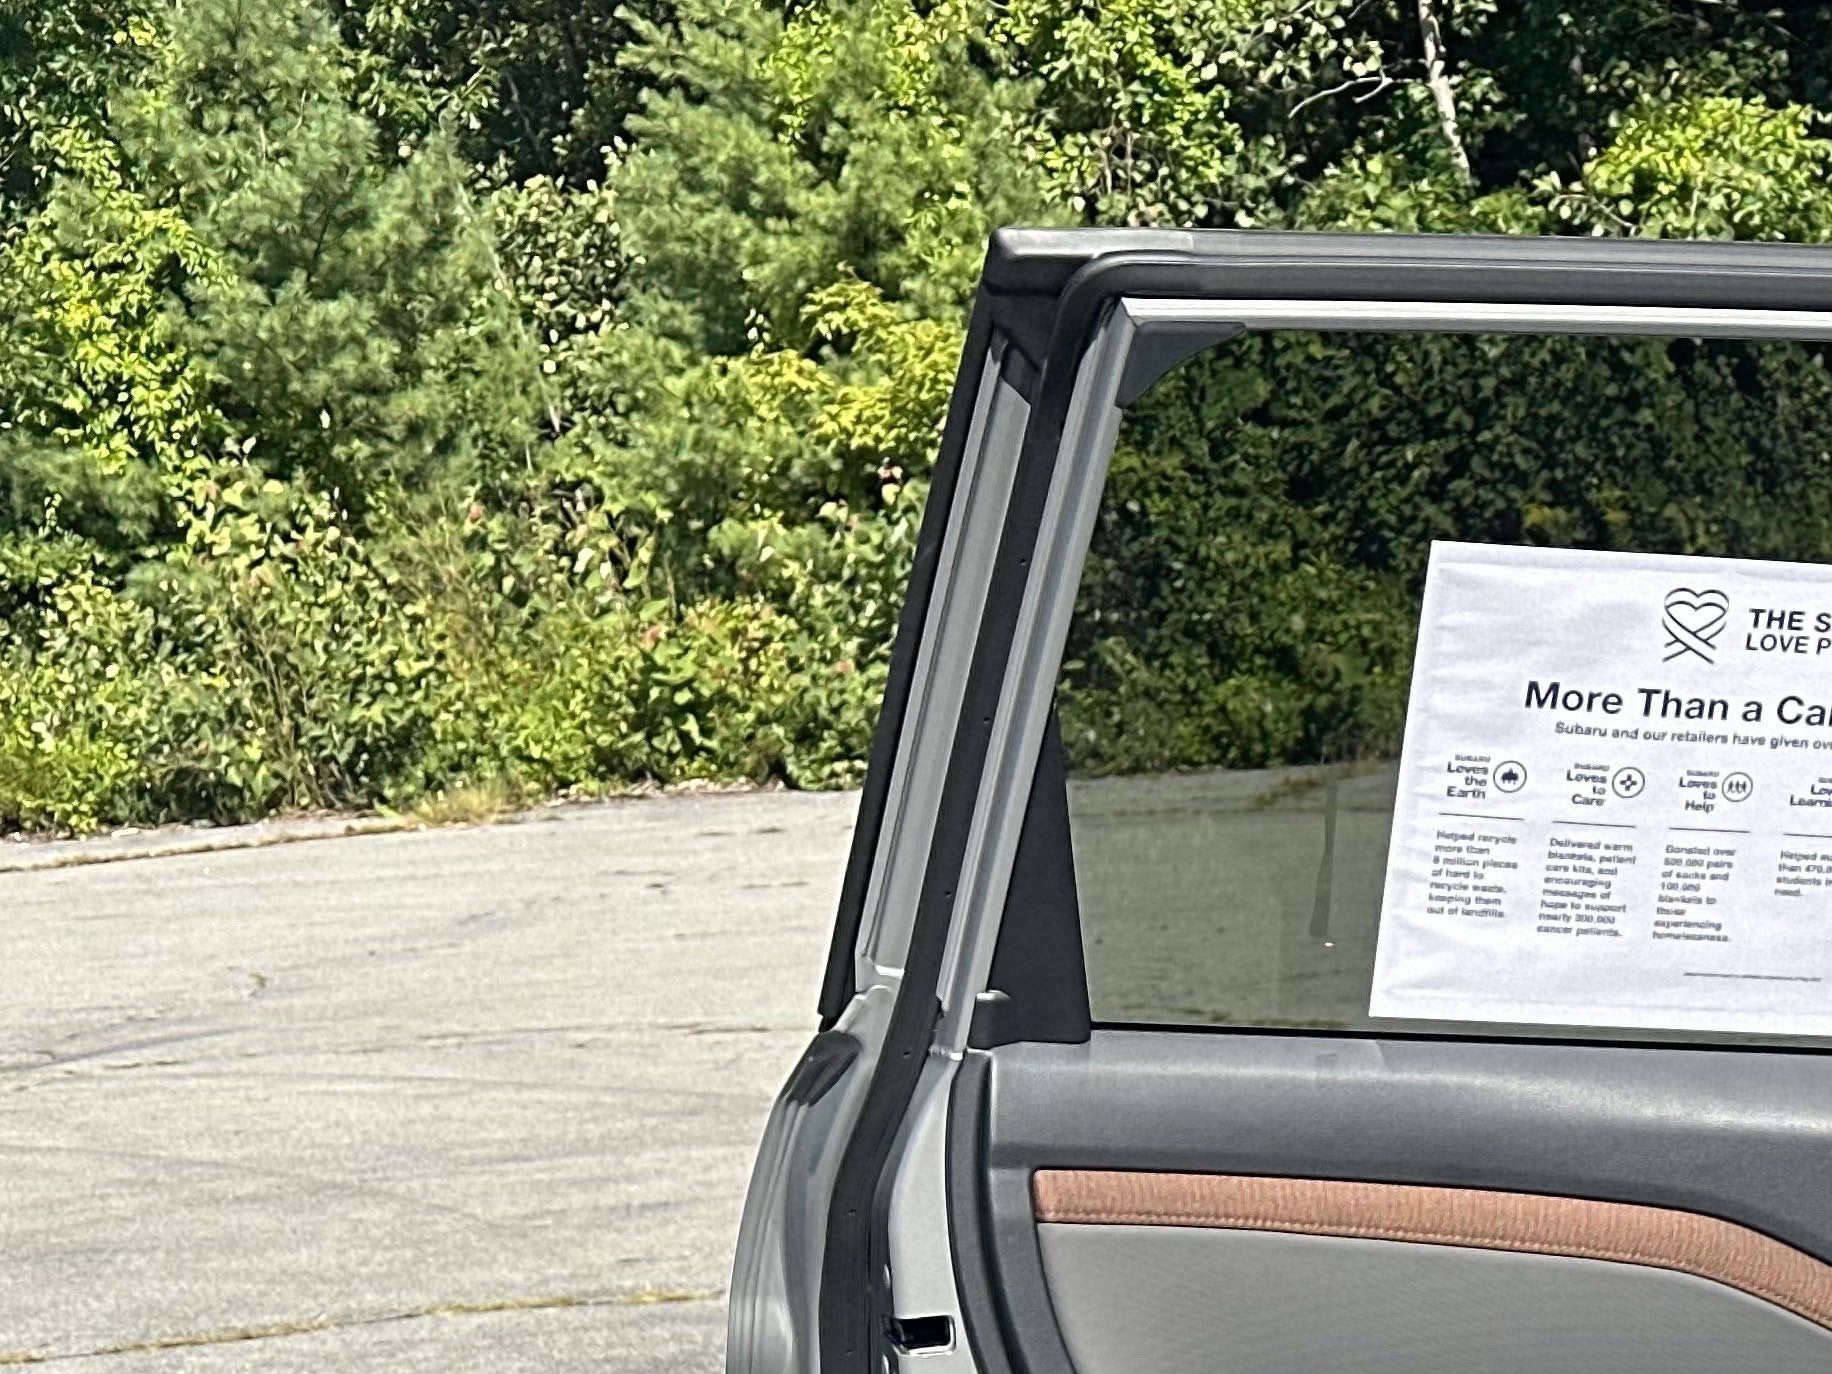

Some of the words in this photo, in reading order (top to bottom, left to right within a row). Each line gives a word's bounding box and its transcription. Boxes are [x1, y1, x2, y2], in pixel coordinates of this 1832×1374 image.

[1749, 608, 1806, 631] THE
[1745, 633, 1810, 654] LOVE
[1525, 680, 1624, 715] More
[1638, 687, 1729, 721] Than
[1742, 700, 1763, 723] a
[1554, 721, 1608, 738] Subaru
[1612, 728, 1639, 740] and
[1643, 731, 1668, 742] our
[1671, 730, 1729, 744] retailers
[1733, 734, 1767, 747] have
[1770, 735, 1808, 750] given
[1447, 761, 1490, 776] Loves
[1465, 774, 1488, 787] the
[1566, 770, 1608, 784] Loves
[1679, 776, 1718, 790] Loves
[1447, 785, 1487, 800] Earth
[1592, 784, 1607, 796] to
[1703, 790, 1717, 801] to
[1571, 793, 1606, 807] Care
[1685, 799, 1715, 814] Help
